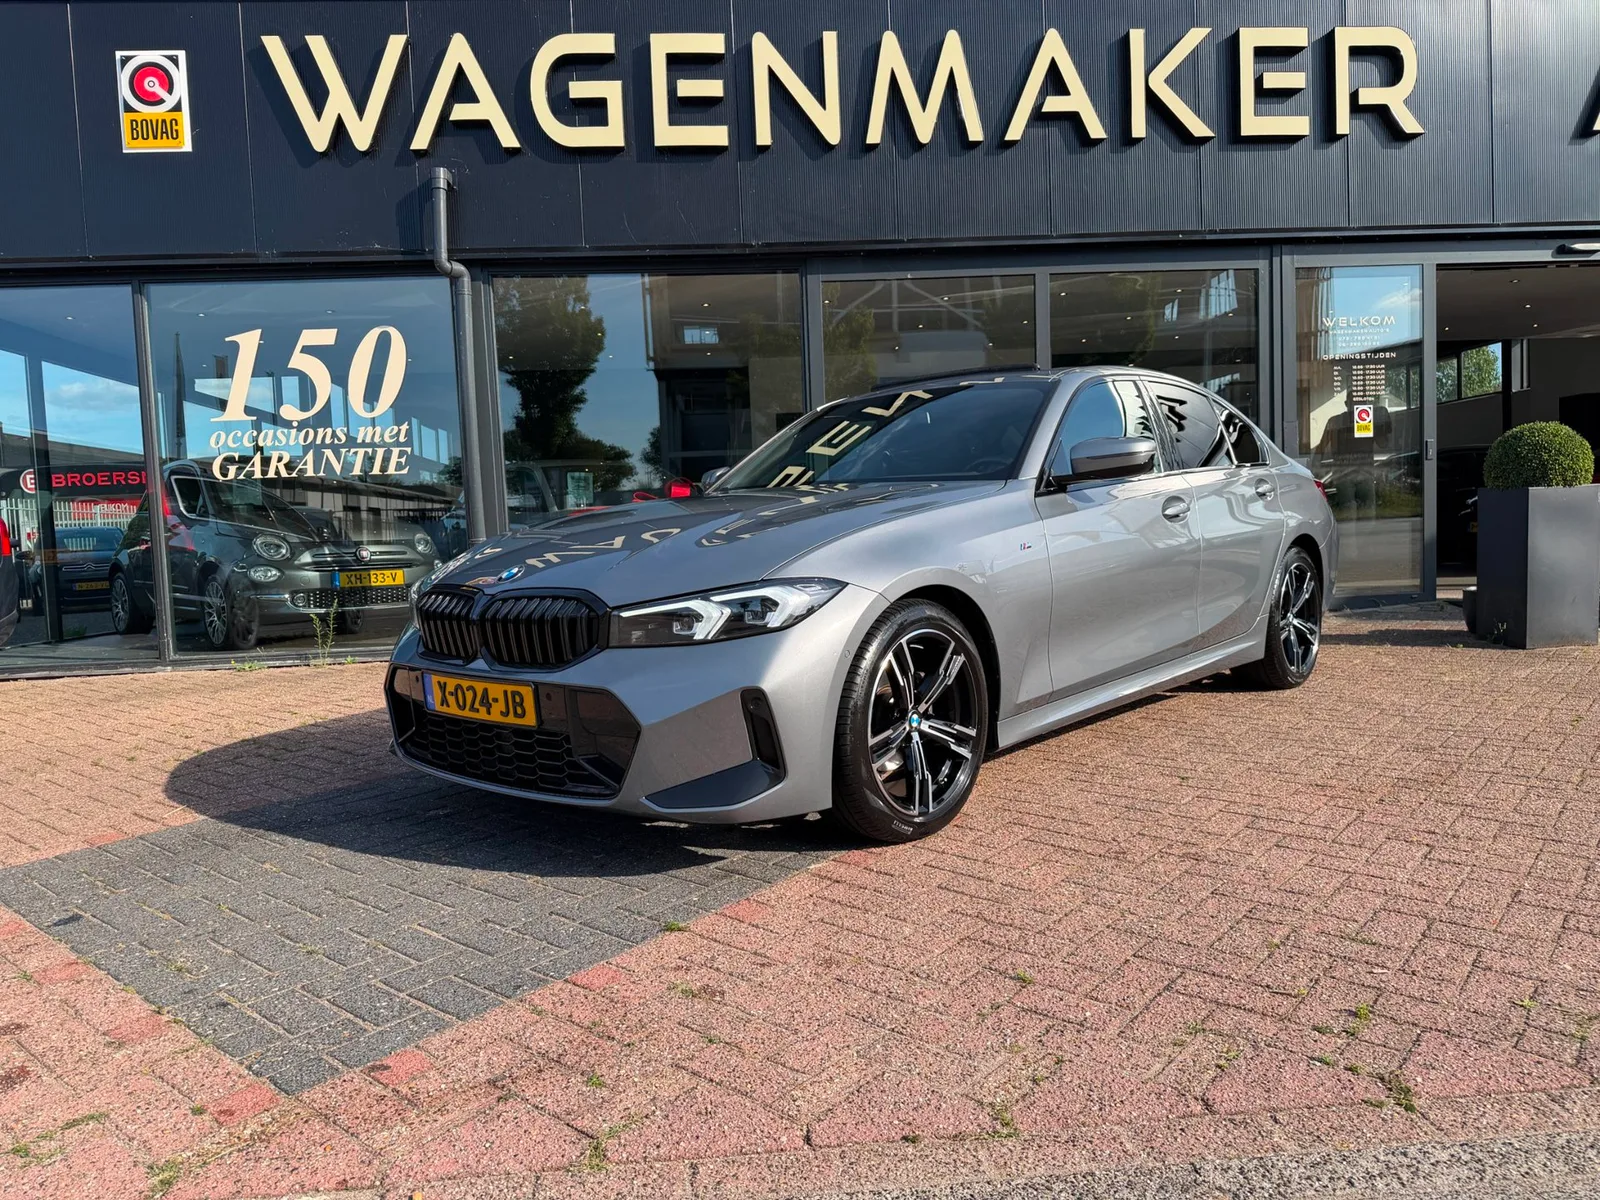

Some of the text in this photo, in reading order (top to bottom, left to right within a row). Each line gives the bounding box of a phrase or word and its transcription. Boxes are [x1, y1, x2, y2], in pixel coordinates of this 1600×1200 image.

[261, 26, 1424, 153] WAGENMAKER
[130, 118, 179, 141] BOVAG
[1322, 315, 1396, 326] WELKOM
[1322, 352, 1397, 360] OPENINGSTIJDEN
[210, 325, 407, 422] 150
[209, 420, 410, 449] occasions met
[211, 447, 412, 481] GARANTIE
[346, 572, 397, 585] XH-133-V
[436, 680, 526, 718] X-024-JB
